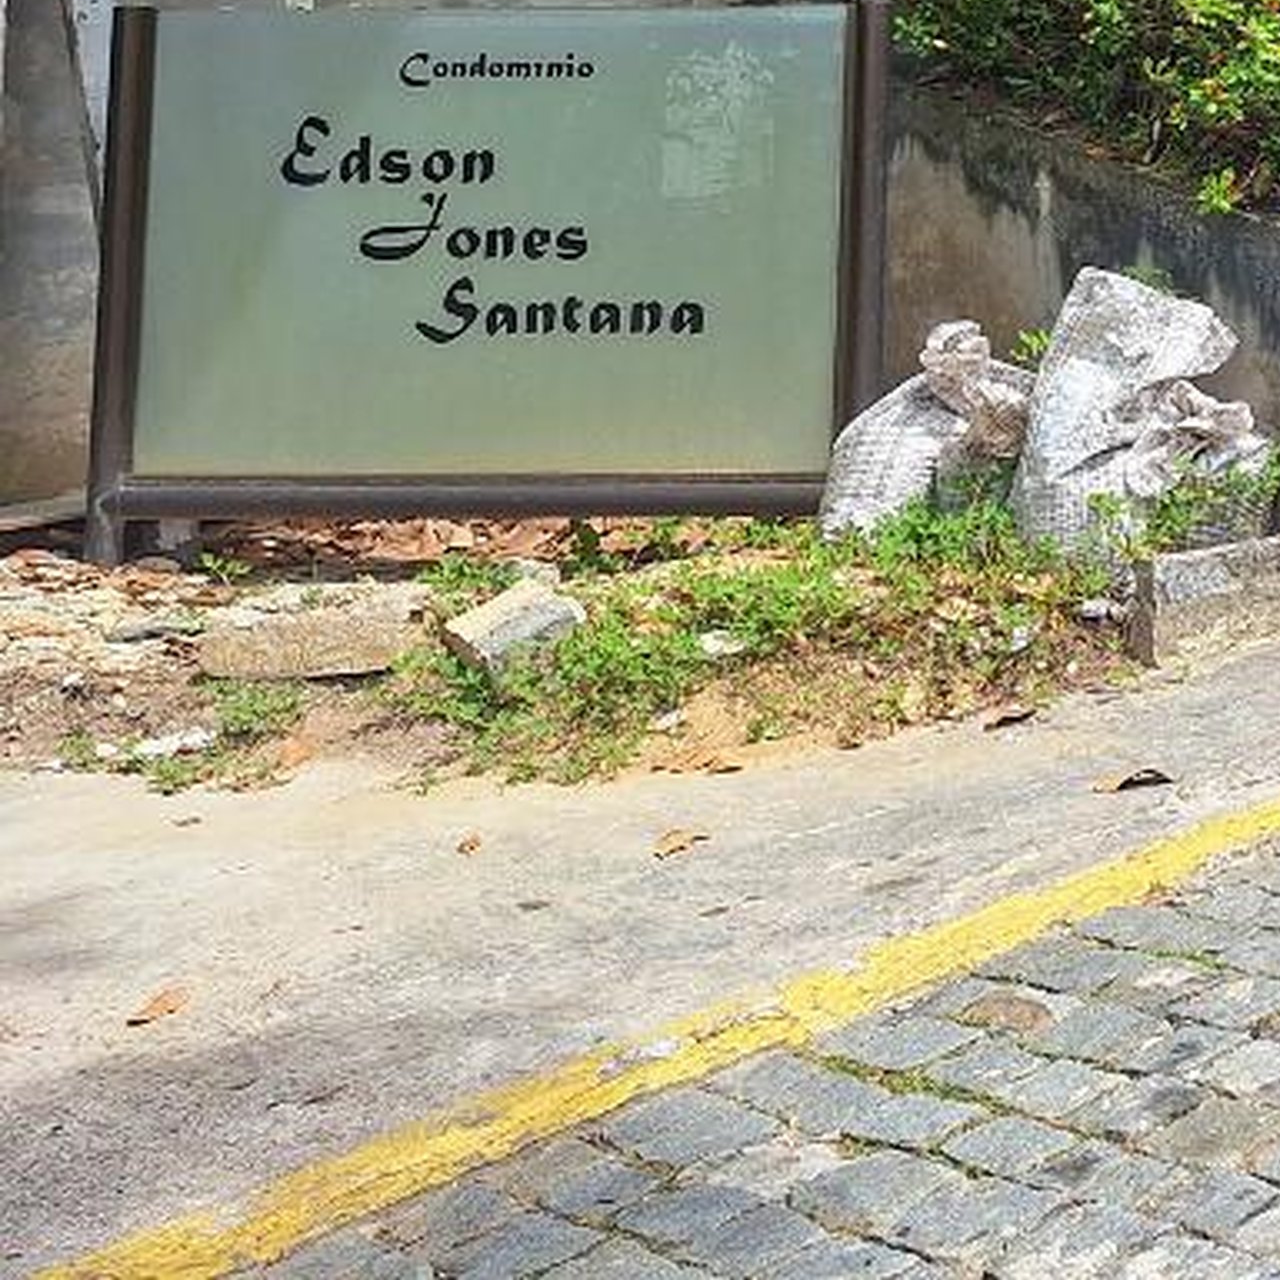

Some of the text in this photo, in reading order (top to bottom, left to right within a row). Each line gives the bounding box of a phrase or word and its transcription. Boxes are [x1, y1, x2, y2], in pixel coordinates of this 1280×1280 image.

[280, 116, 495, 186] Edson
[359, 192, 589, 260] Jones
[414, 277, 705, 343] Santana
